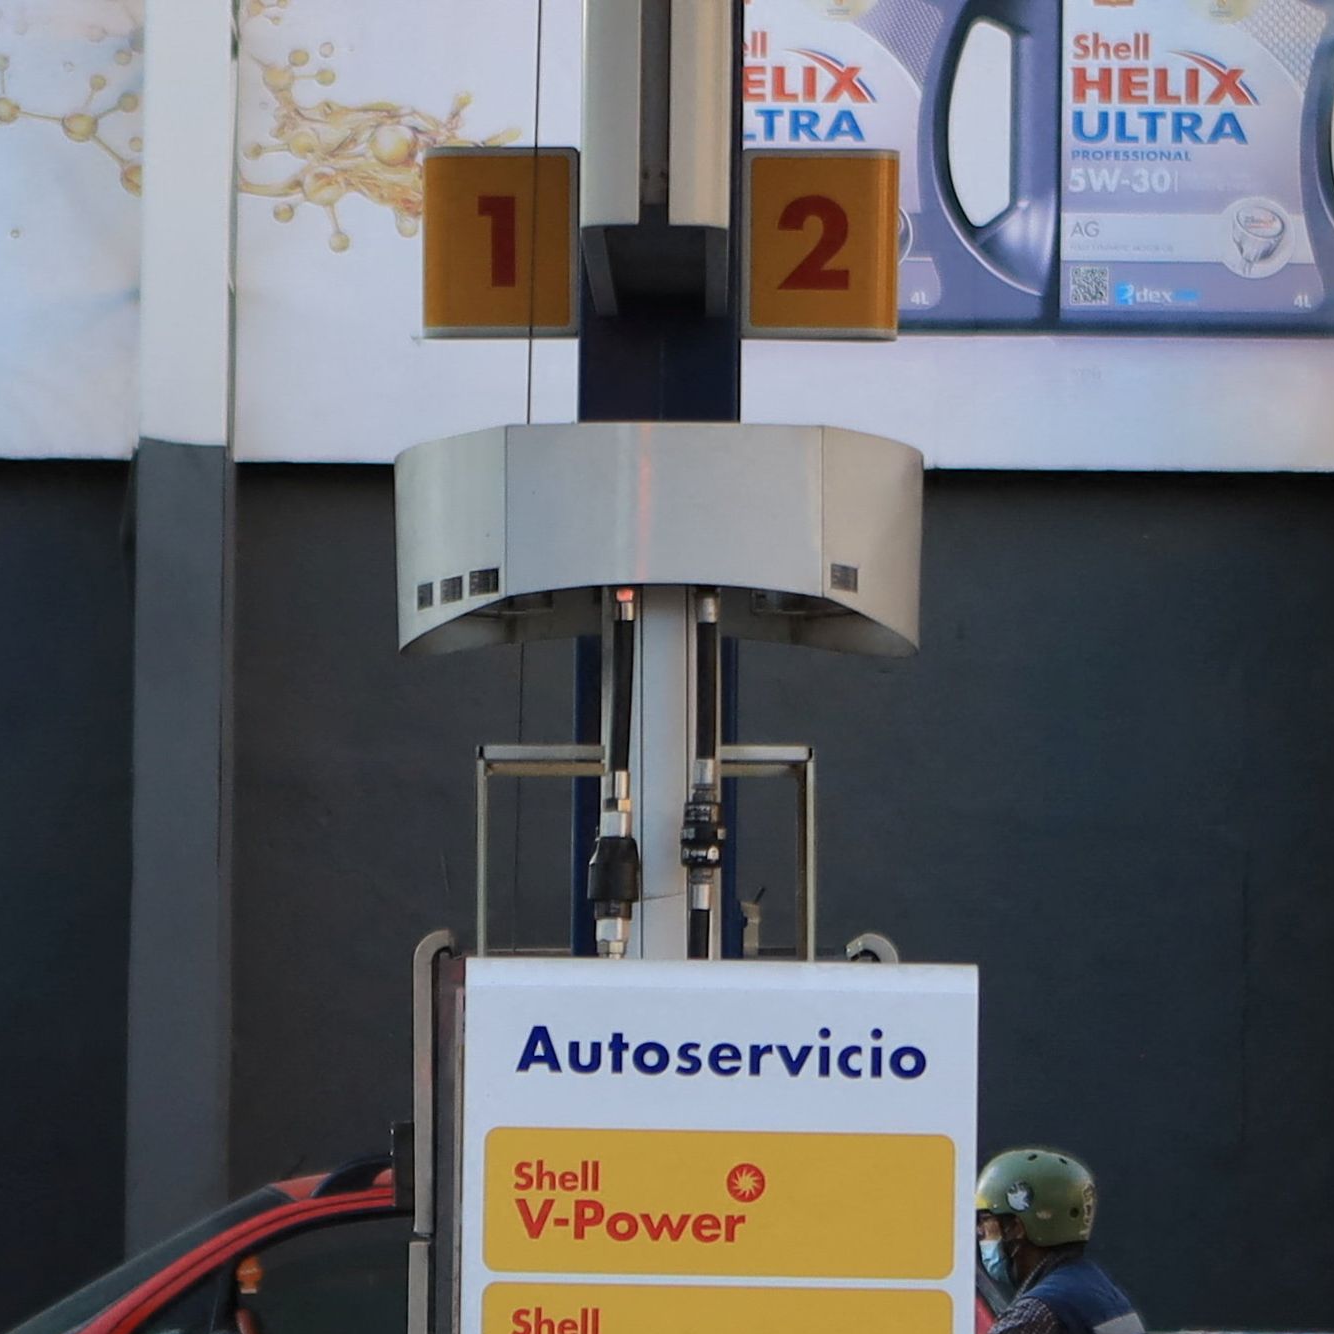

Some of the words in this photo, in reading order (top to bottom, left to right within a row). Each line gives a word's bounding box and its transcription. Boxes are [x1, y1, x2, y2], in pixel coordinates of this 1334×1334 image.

[1073, 34, 1150, 61] Shell
[744, 65, 874, 102] ELIX
[1071, 66, 1257, 106] HELIX
[744, 109, 866, 142] TRA
[1072, 111, 1248, 145] ULTRA
[1071, 150, 1192, 162] PROFESSIONAL
[1069, 167, 1169, 193] 5W-30
[478, 196, 516, 287] 1
[777, 195, 850, 290] 2
[1071, 221, 1100, 238] AG
[910, 292, 930, 306] 4L
[1293, 295, 1312, 309] 4L
[516, 1025, 927, 1080] Autoservicio
[513, 1160, 600, 1192] Shell
[514, 1198, 746, 1243] V-Power
